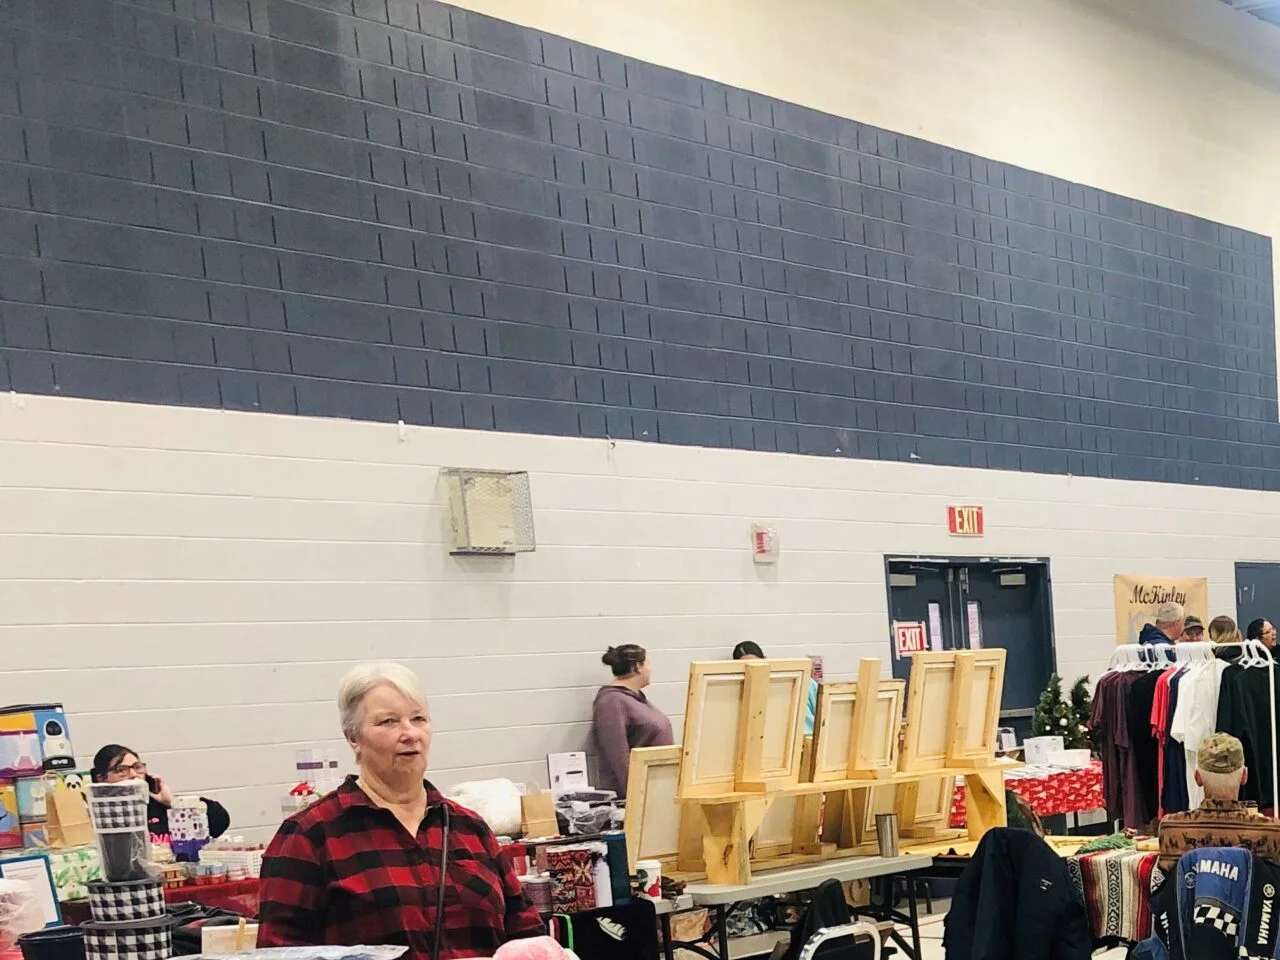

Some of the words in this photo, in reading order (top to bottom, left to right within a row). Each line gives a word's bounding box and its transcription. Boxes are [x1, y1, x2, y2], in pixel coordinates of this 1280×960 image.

[955, 507, 979, 534] EXIT
[1129, 584, 1186, 606] McKinley
[898, 627, 921, 651] EXIT
[1191, 859, 1239, 881] YMAHA
[1257, 899, 1274, 945] YAMAHA
